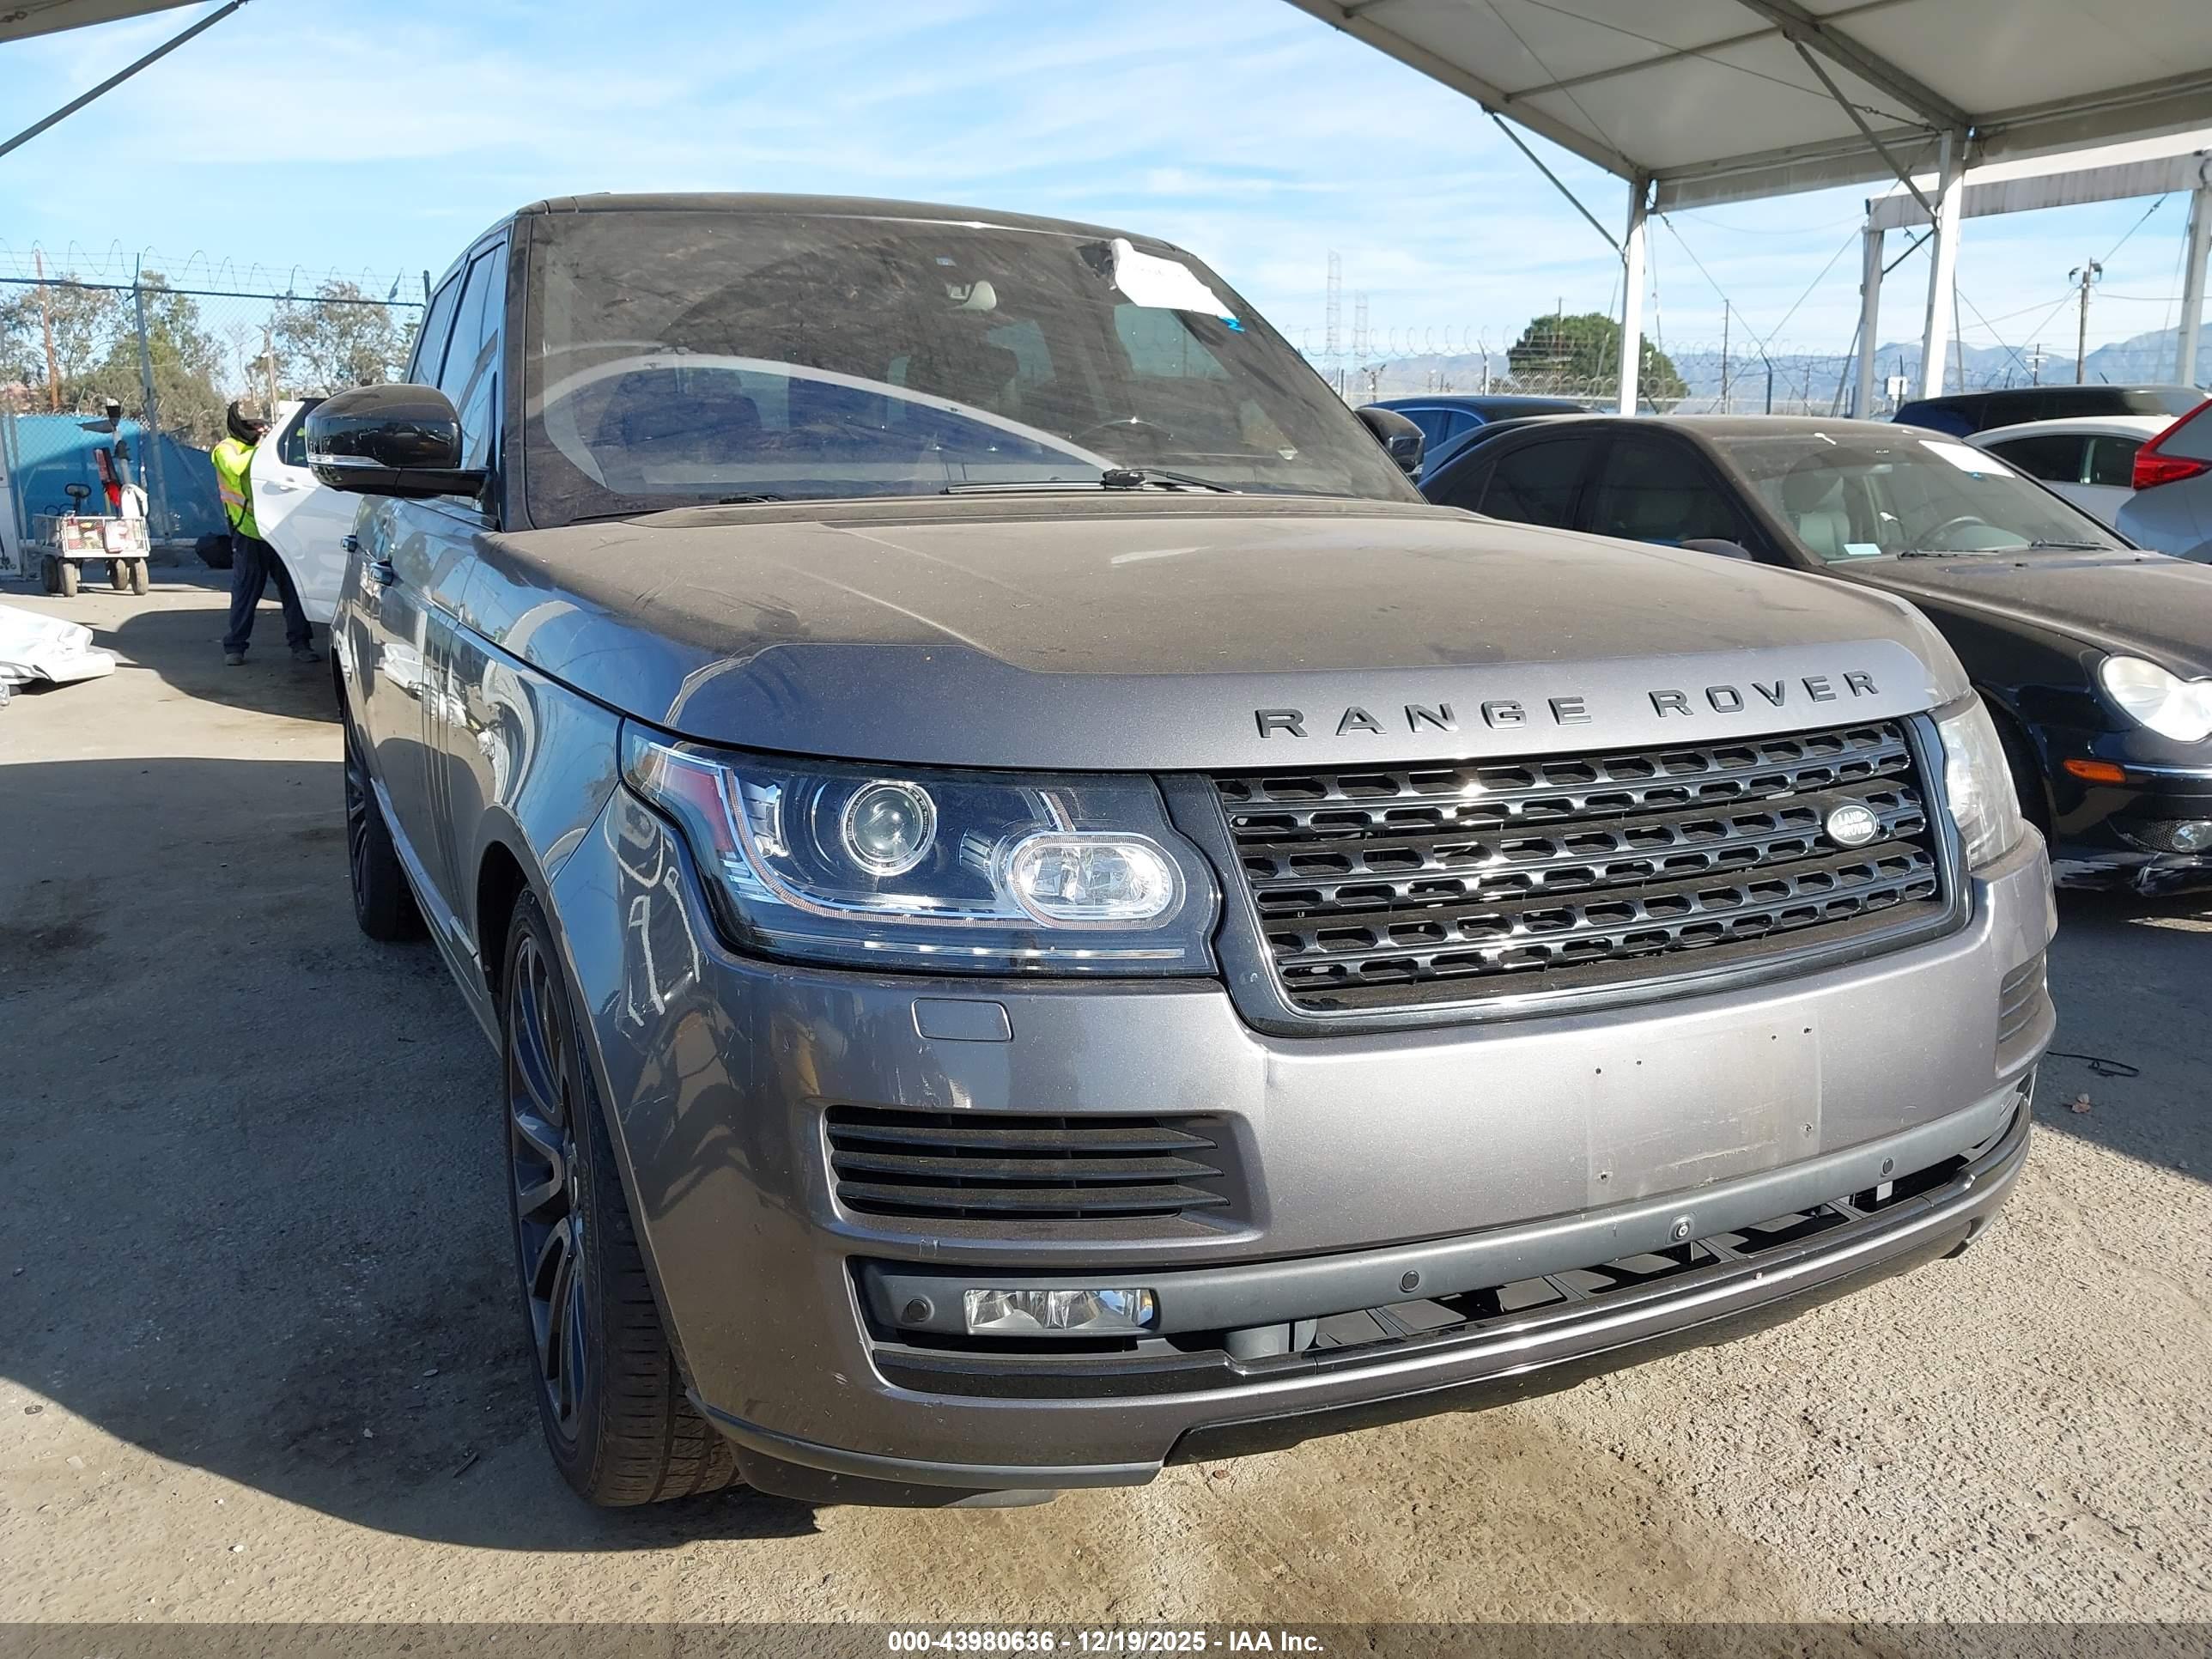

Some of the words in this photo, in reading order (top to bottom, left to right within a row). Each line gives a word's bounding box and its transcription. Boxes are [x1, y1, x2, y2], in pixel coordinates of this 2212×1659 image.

[1255, 696, 1593, 739] RANGE
[1648, 670, 1880, 719] ROVER
[1838, 811, 1863, 825] LAND
[1844, 821, 1872, 837] ROVER
